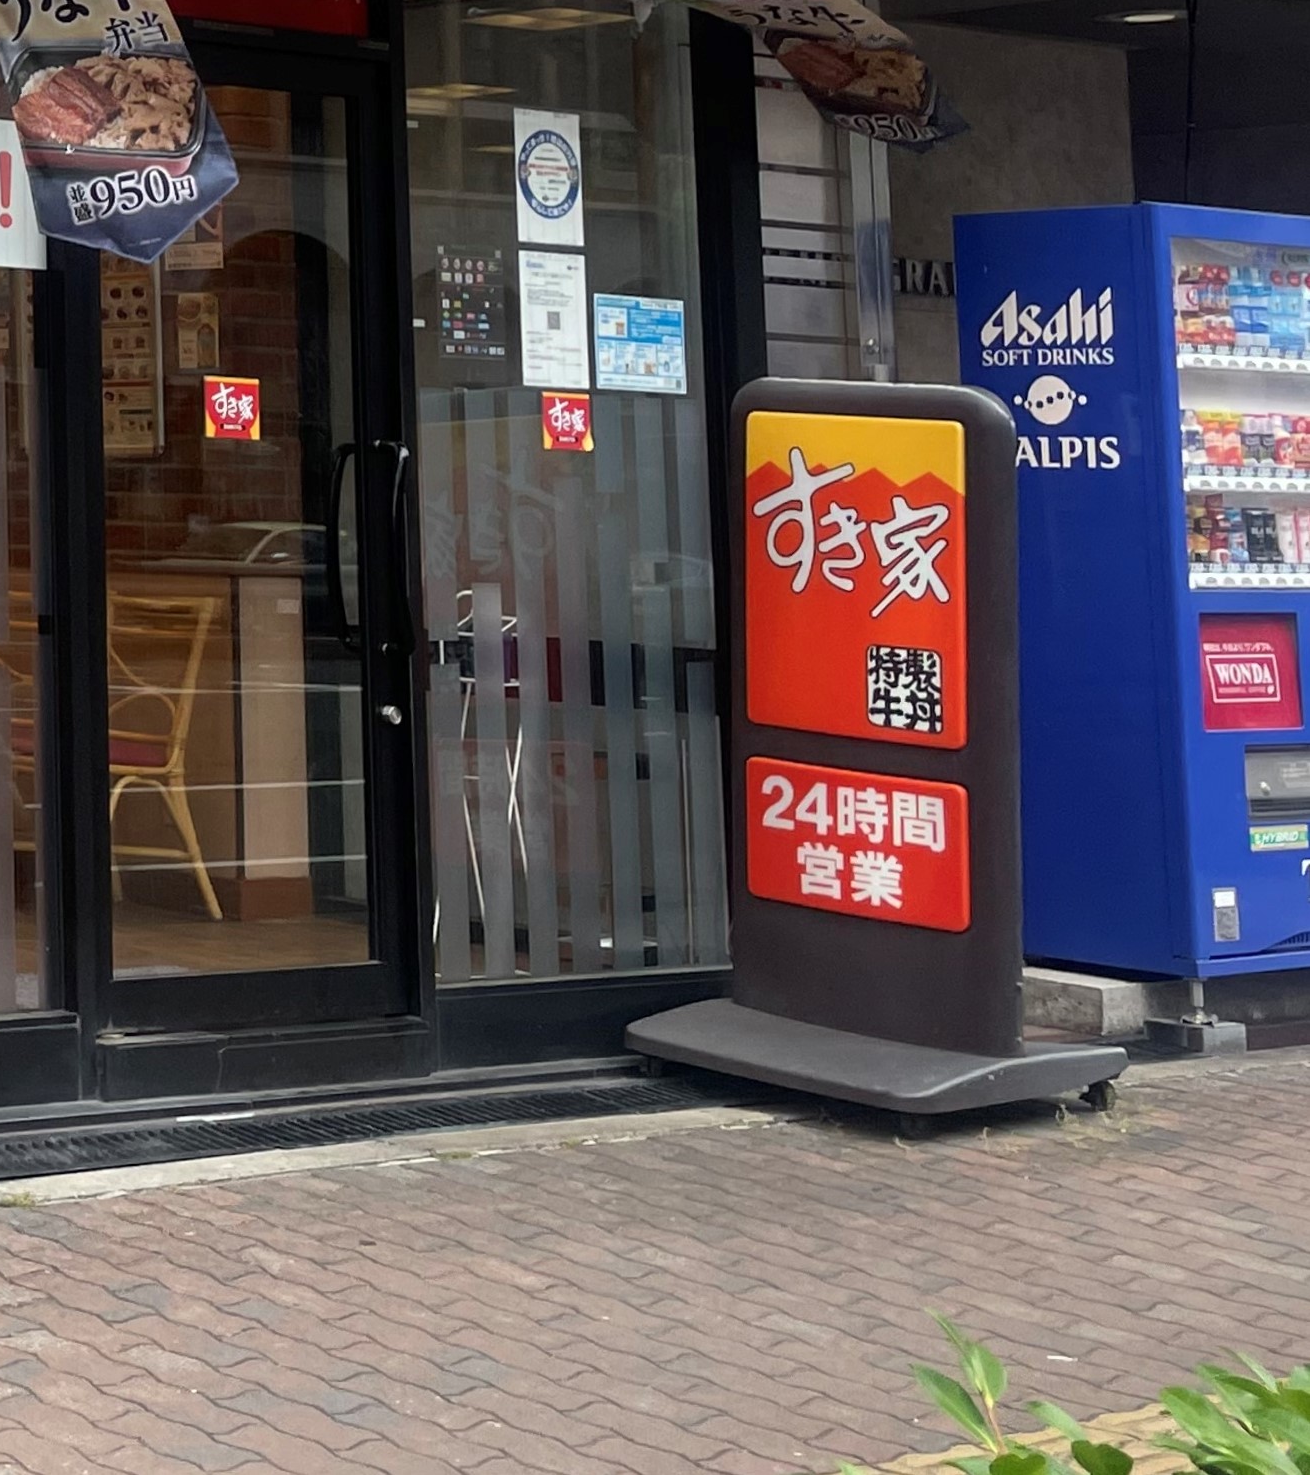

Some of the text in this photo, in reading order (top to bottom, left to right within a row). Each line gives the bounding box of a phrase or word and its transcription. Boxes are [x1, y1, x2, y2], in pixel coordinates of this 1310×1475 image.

[105, 11, 170, 53] 弁当
[90, 167, 195, 217] 950円
[980, 287, 1114, 347] Asahi
[981, 347, 1114, 367] SOFT DRINKS
[211, 382, 254, 424] すき家
[548, 397, 586, 436] すき家
[1015, 436, 1121, 469] ALPIS
[752, 446, 951, 618] すき家
[1213, 663, 1273, 685] WONDA
[761, 775, 945, 853] 24時間
[1262, 831, 1299, 843] HYBRID
[797, 841, 902, 909] 営業
